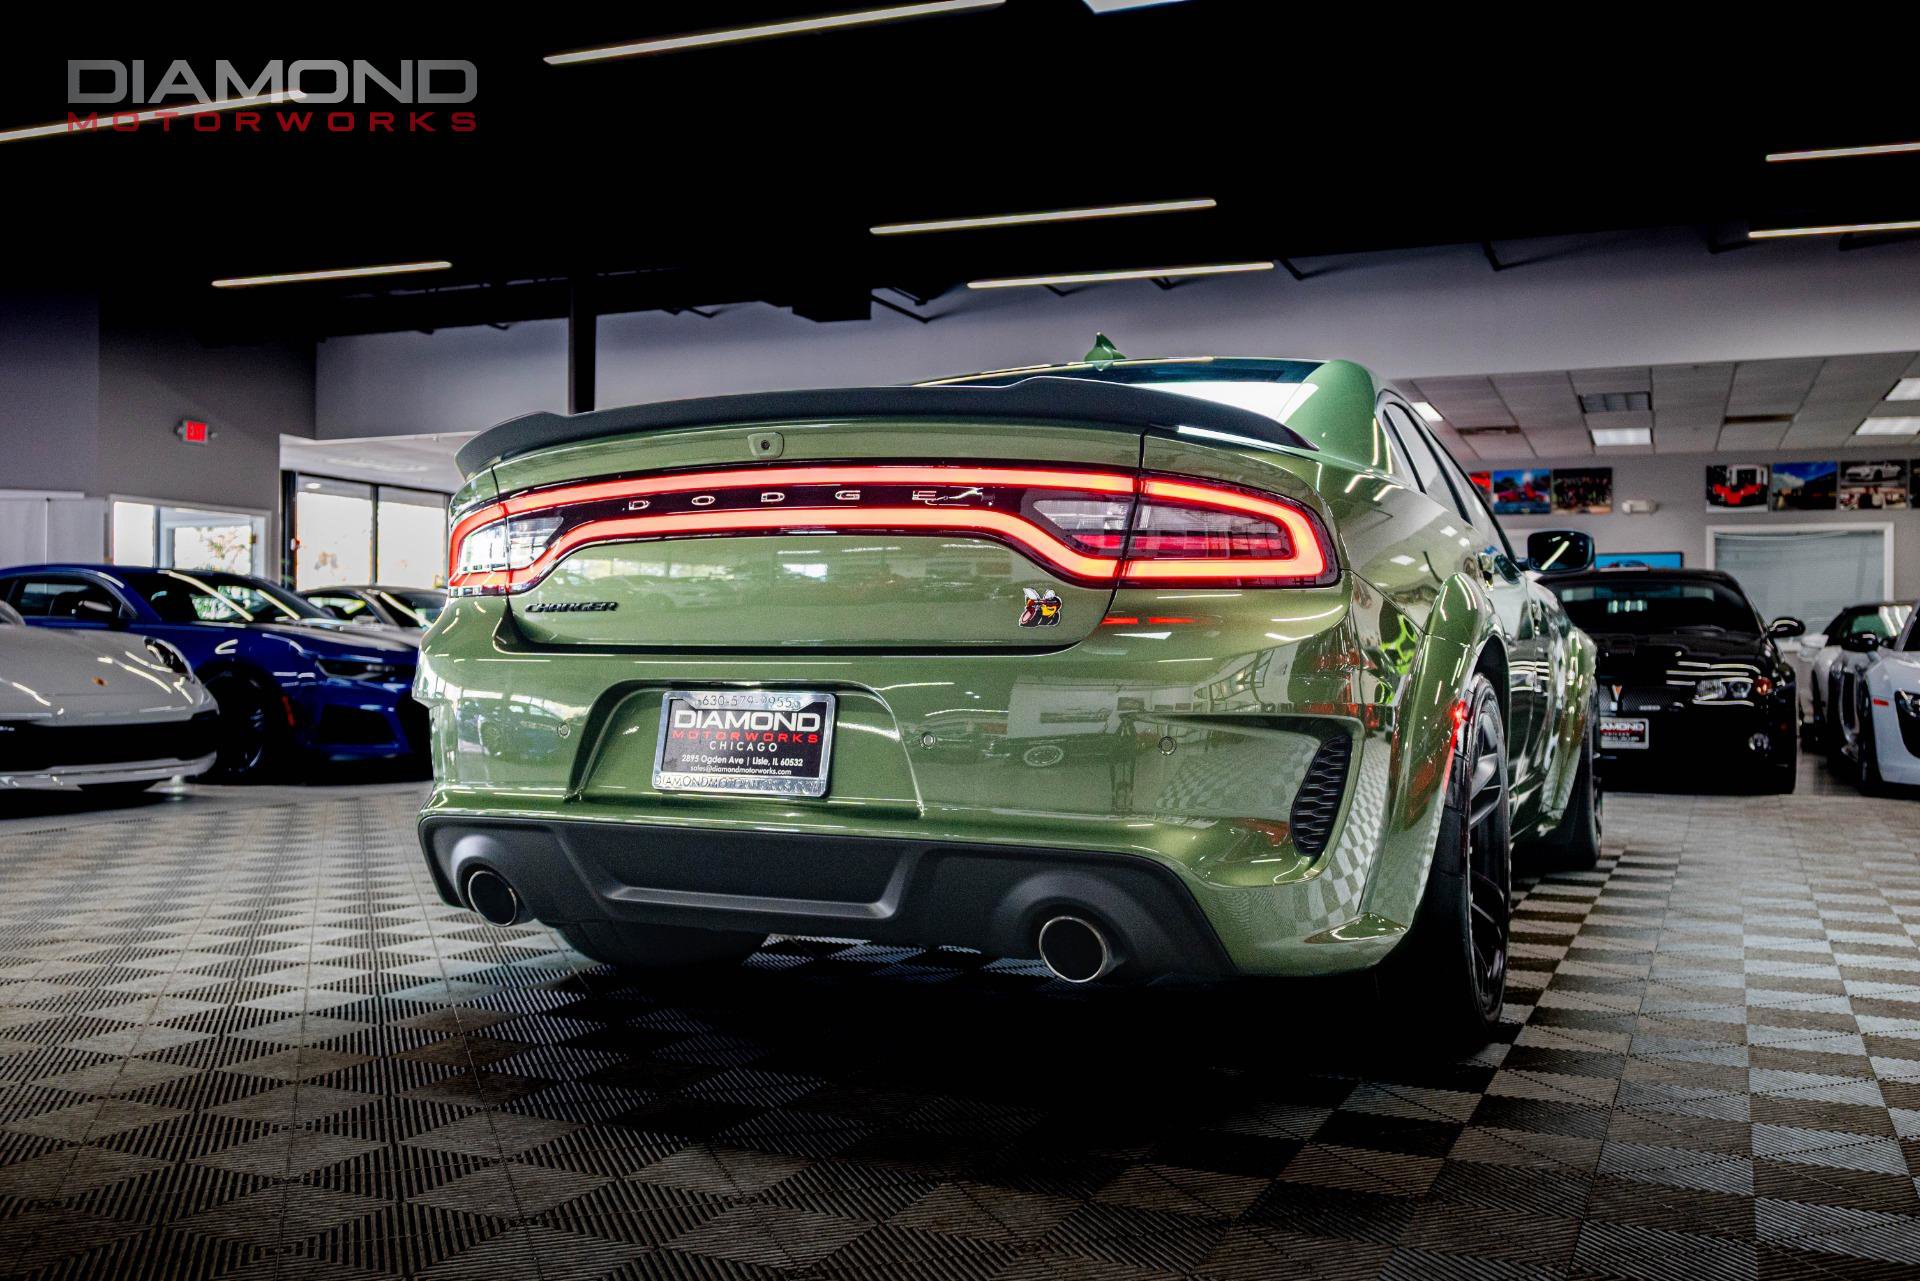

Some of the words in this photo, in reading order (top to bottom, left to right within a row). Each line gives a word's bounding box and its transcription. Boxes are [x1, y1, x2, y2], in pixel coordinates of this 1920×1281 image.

[628, 490, 937, 511] DODGE
[525, 601, 619, 613] CHARGER
[673, 709, 821, 732] DIAMOND
[1600, 722, 1645, 731] AMOND
[671, 730, 819, 744] MOTORWORKS
[709, 740, 778, 752] CHICAGO
[682, 754, 700, 763] 2895
[701, 754, 728, 765] Ogden
[728, 756, 744, 765] Ave
[772, 757, 779, 766] IL
[780, 758, 804, 767] 60532
[690, 764, 792, 776] sales@diamondmotorworks.com
